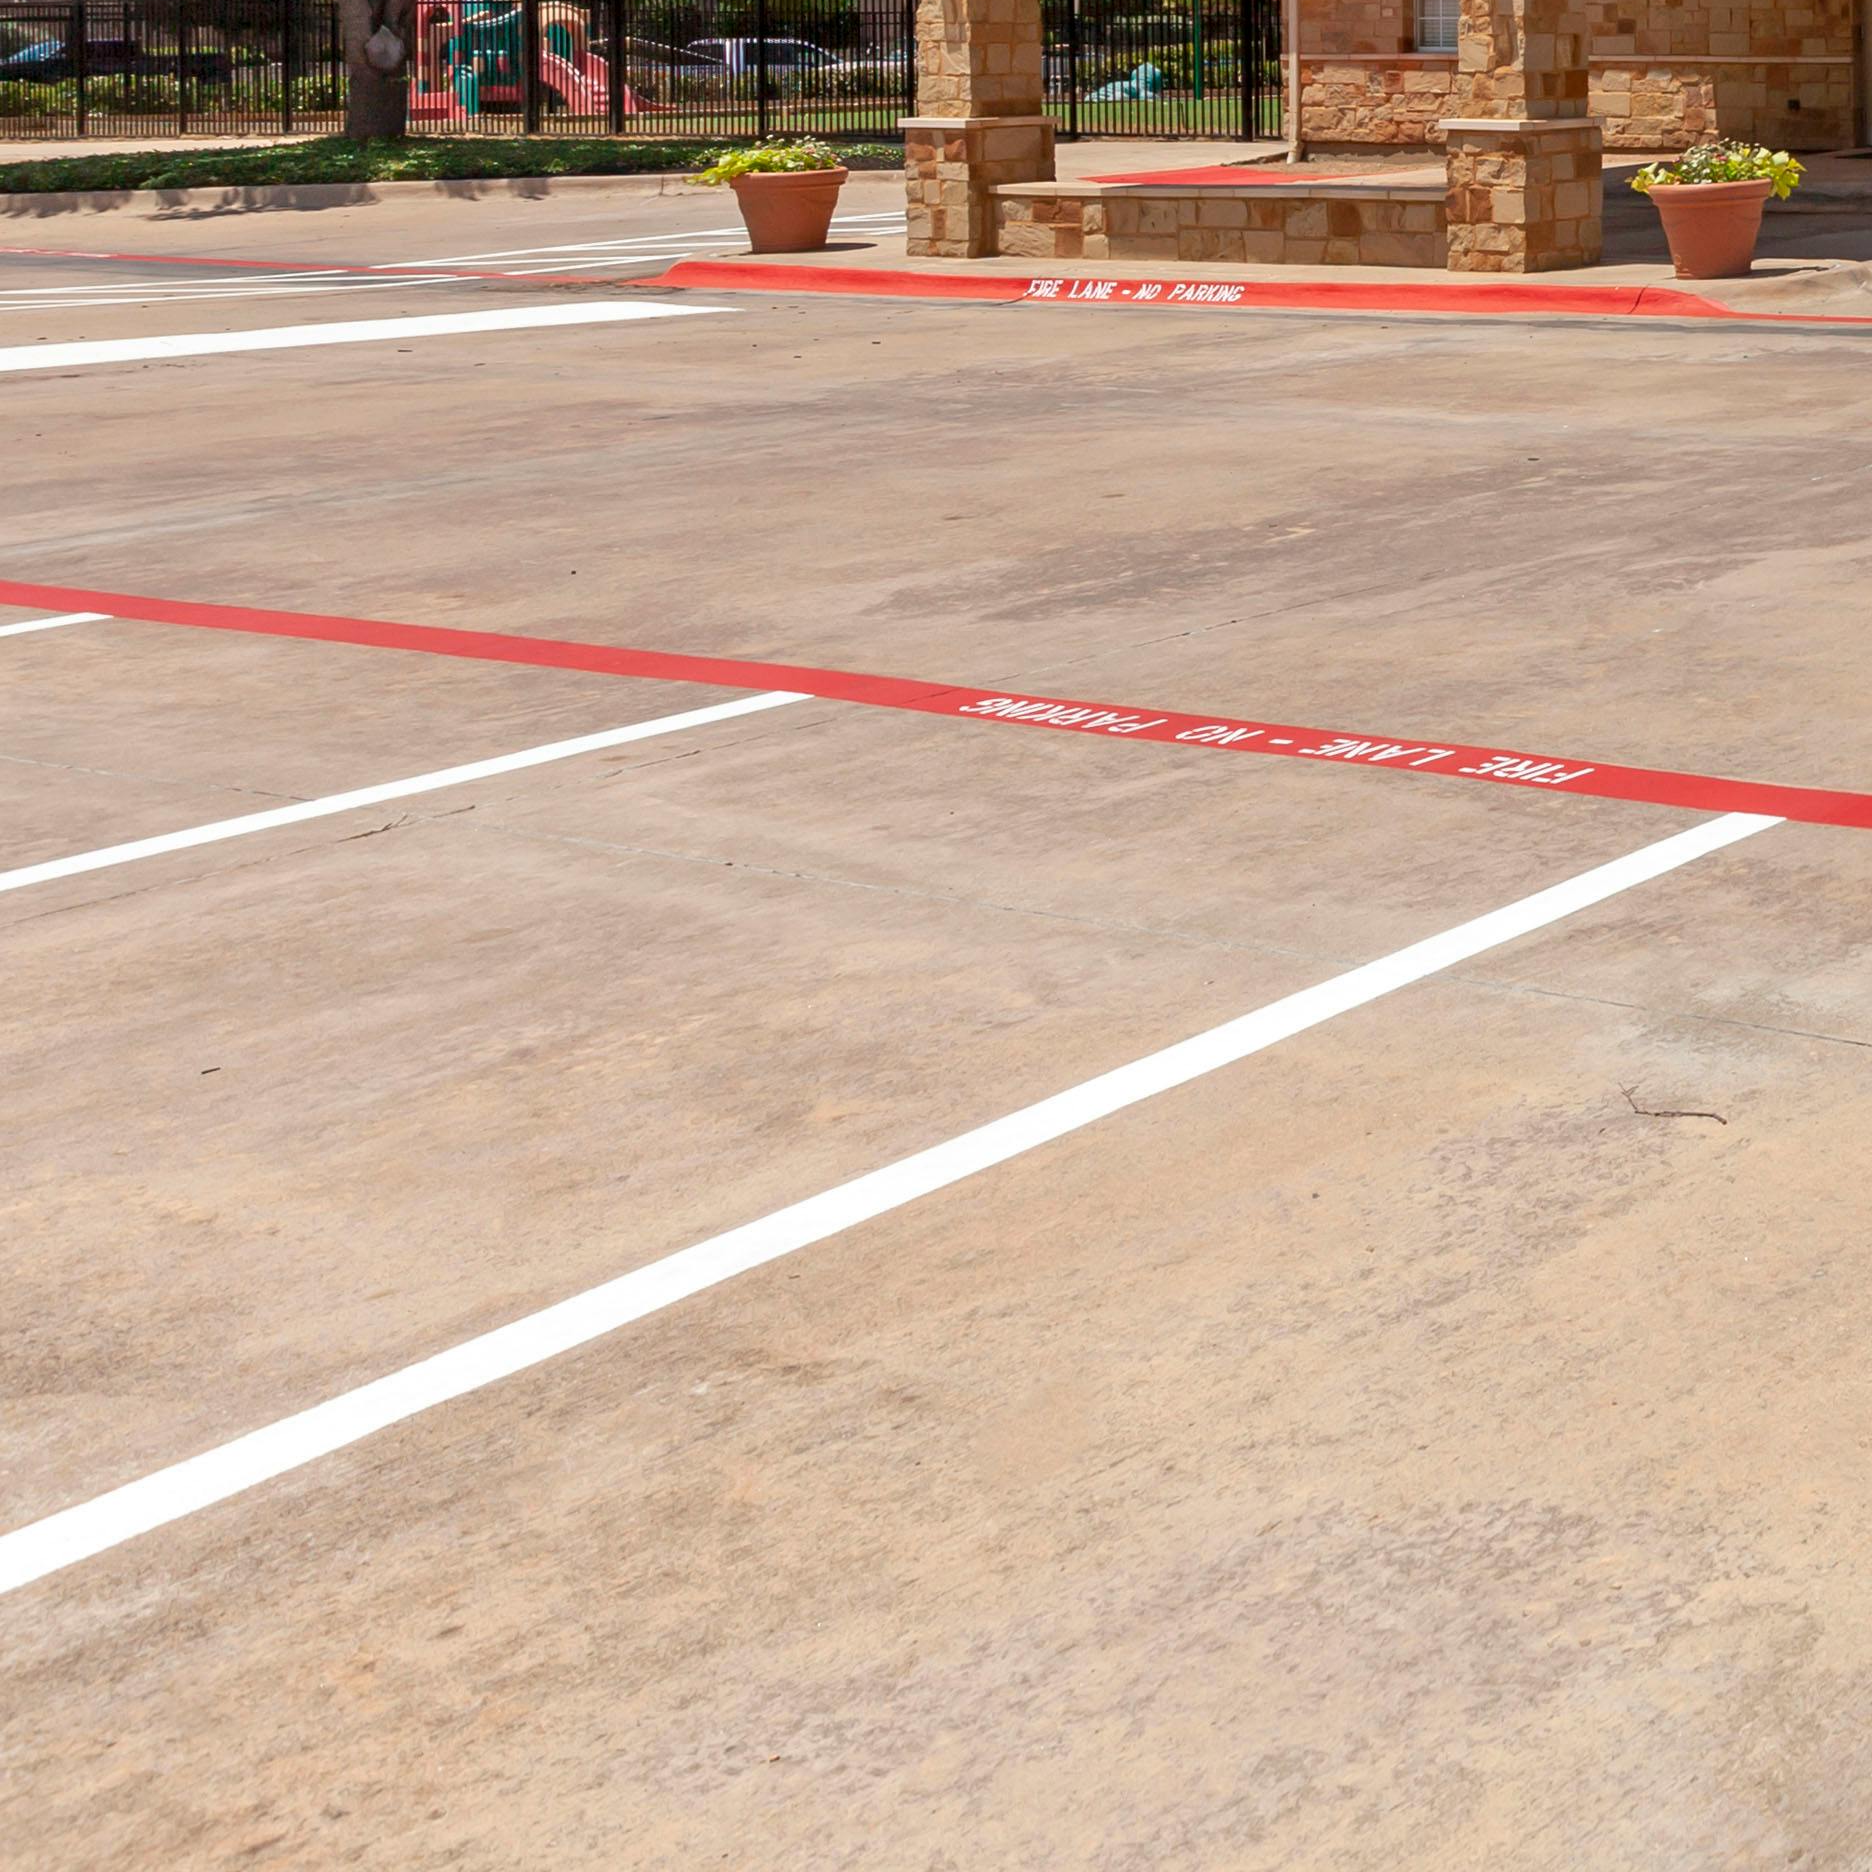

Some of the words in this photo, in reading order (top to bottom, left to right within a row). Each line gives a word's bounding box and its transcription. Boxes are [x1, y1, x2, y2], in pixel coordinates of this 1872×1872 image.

[1023, 279, 1064, 297] FIRE
[1068, 280, 1117, 300] LANE
[1132, 284, 1162, 300] NO
[1167, 284, 1245, 302] PARKING
[958, 697, 1169, 734] PARKING
[1175, 725, 1265, 745] NO
[1298, 738, 1456, 767] LANE
[1458, 756, 1595, 784] FIRE
